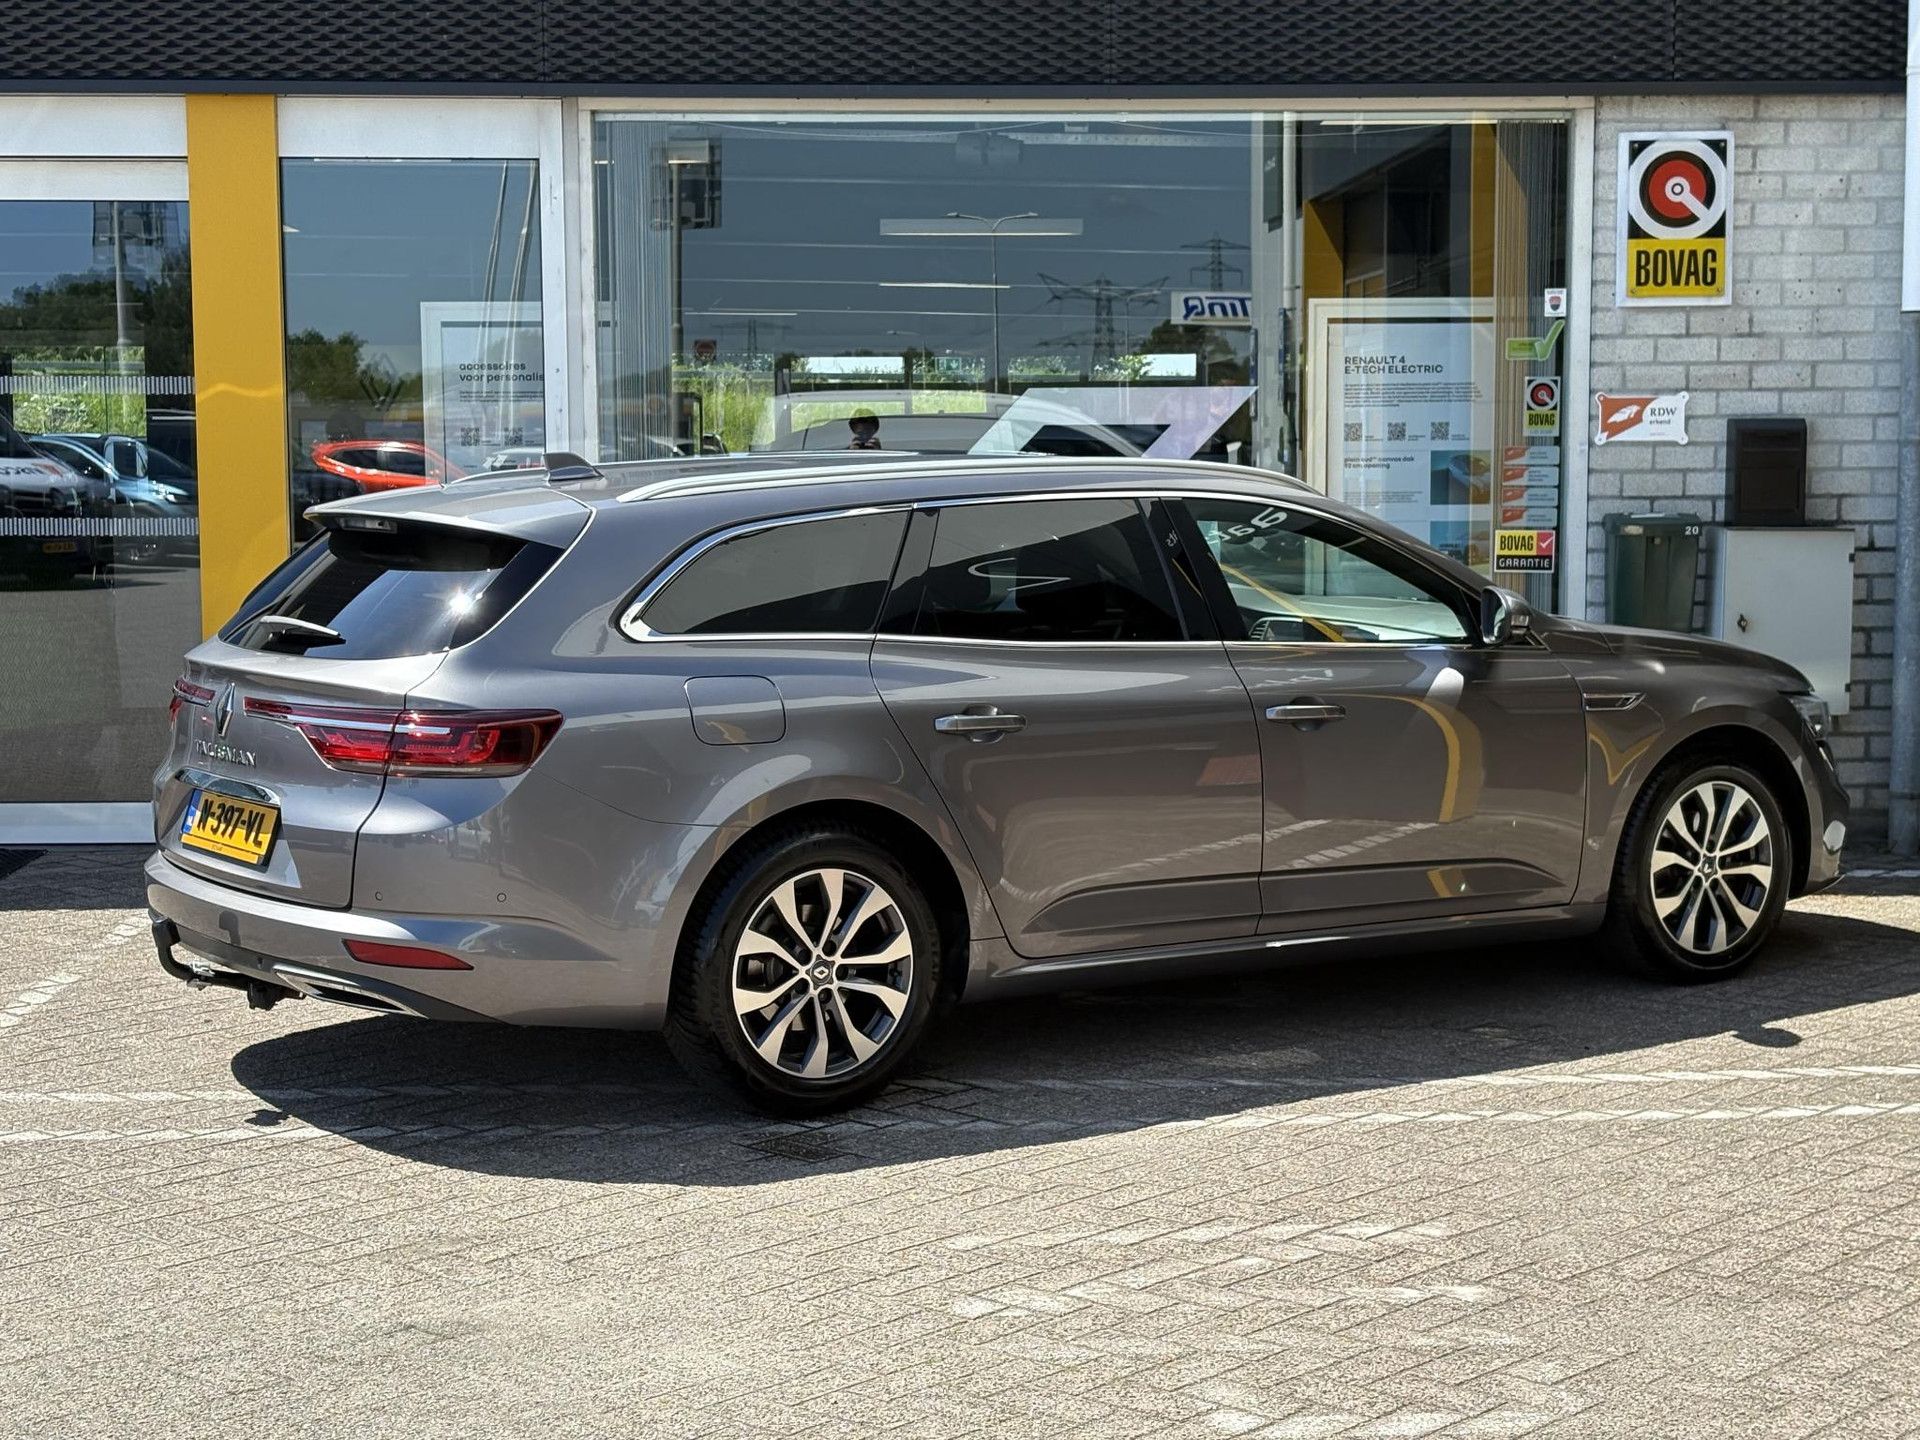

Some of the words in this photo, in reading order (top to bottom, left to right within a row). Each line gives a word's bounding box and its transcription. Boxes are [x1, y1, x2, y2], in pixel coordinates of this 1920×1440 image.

[1635, 249, 1717, 287] BOVAG
[1344, 356, 1397, 365] RENAULT
[1398, 355, 1406, 364] 4
[459, 361, 526, 370] accessoires
[1344, 365, 1385, 374] E-TECH
[1388, 364, 1444, 374] ELECTRIC
[459, 373, 484, 381] voor
[1649, 407, 1677, 416] RDW
[1528, 413, 1555, 426] BOVAG
[1685, 525, 1699, 535] 20
[1499, 534, 1534, 551] BOVAG
[1498, 558, 1550, 568] GARANTIE
[195, 739, 256, 766] TALISMAN
[197, 798, 266, 849] N-397-VL
